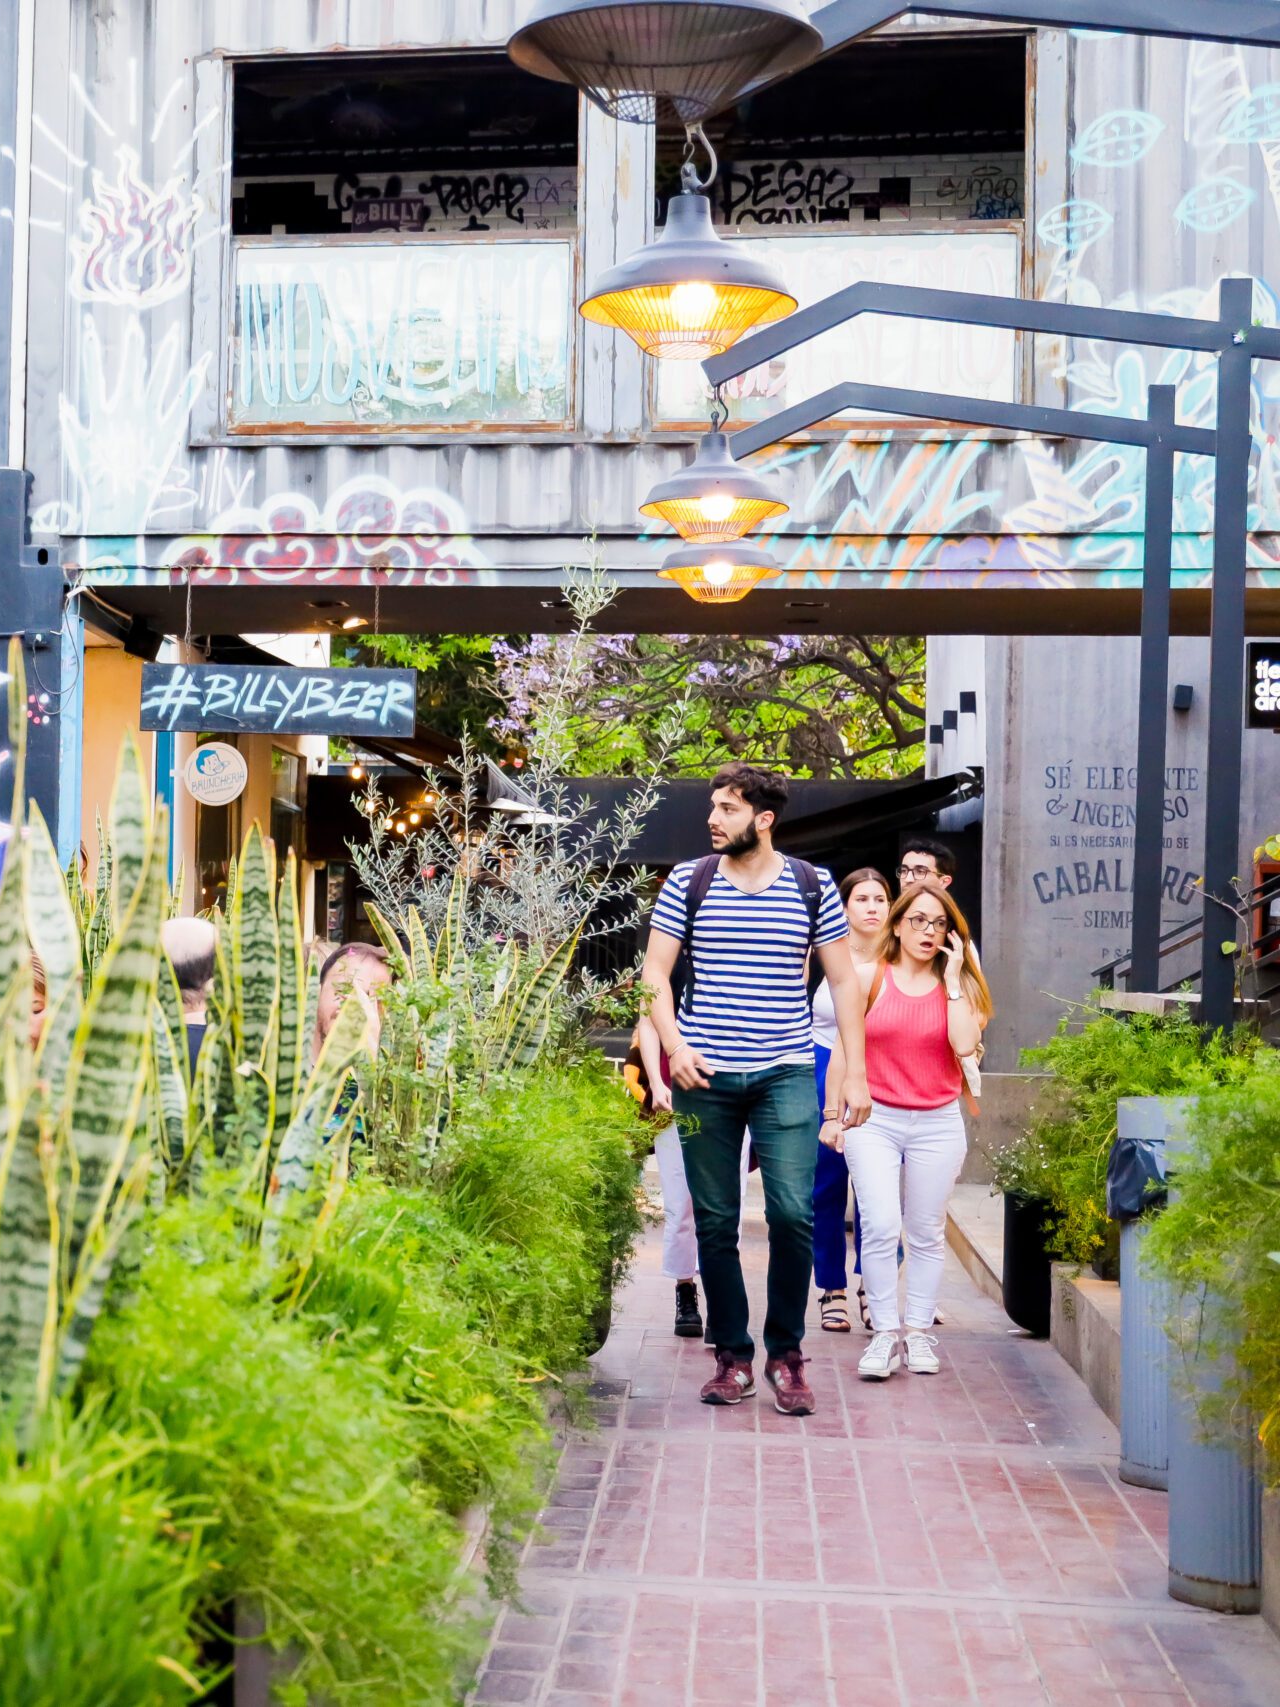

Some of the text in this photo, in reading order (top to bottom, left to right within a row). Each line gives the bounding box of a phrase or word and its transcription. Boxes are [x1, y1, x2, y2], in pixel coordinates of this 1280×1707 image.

[369, 203, 422, 221] BILLY
[140, 665, 415, 730] #BILLYBEER
[1045, 759, 1199, 791] SÉ ELEGNTE
[1071, 796, 1189, 828] INGENSO
[1065, 835, 1078, 847] ES
[1081, 836, 1135, 848] NECESARI
[1176, 837, 1189, 849] SE
[1032, 858, 1201, 906] CABALRO
[1084, 910, 1133, 929] SIEMP
